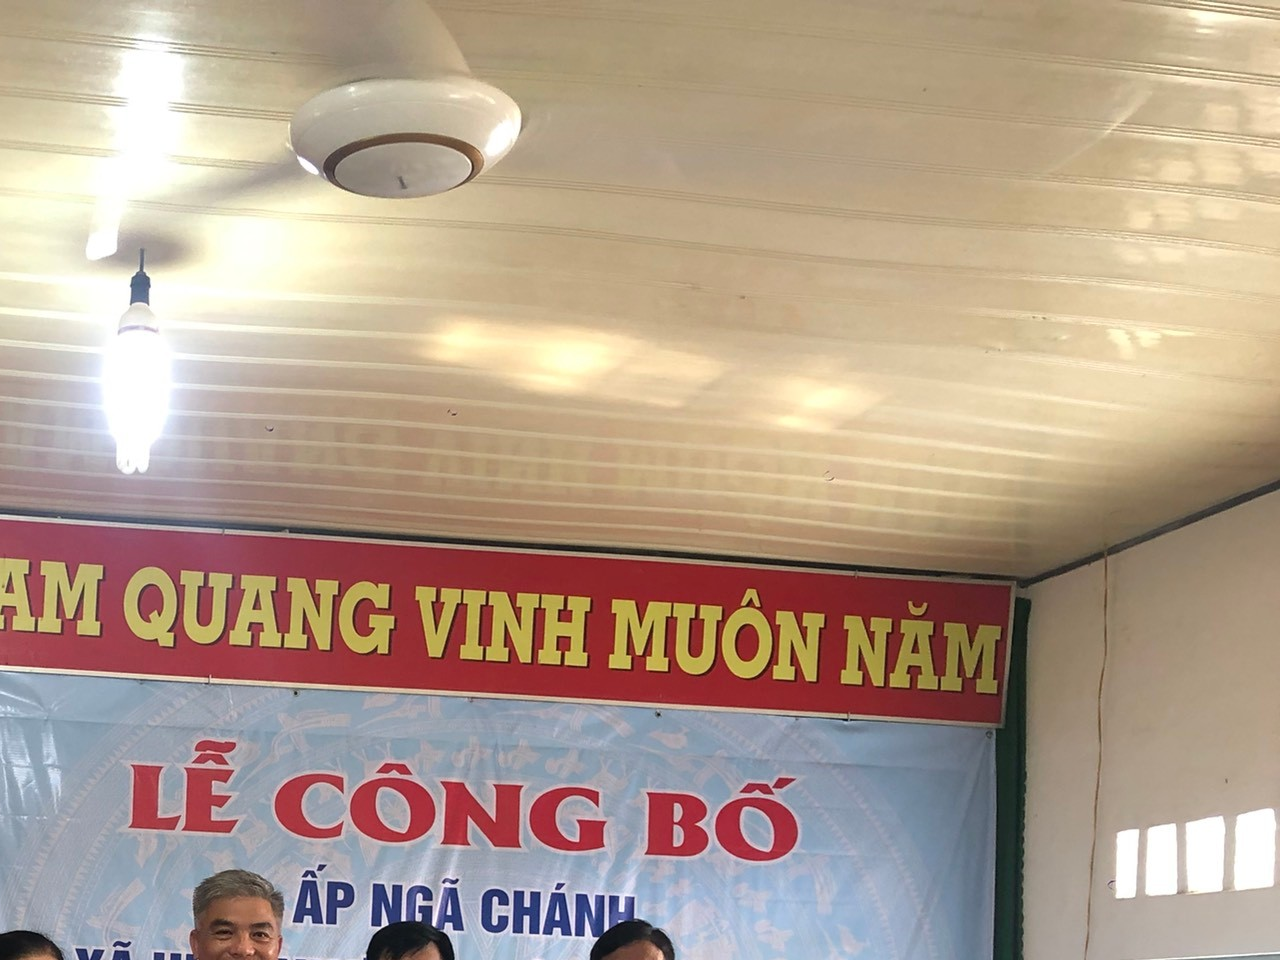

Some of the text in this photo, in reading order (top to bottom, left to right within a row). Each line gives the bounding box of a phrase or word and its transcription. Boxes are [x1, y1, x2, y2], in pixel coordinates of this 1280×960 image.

[123, 566, 395, 655] QUANG
[415, 585, 591, 667] VINH
[608, 588, 825, 682] MUÔN
[840, 600, 1002, 694] NĂM
[128, 740, 799, 862] LỄ CÔNG BỐ
[292, 864, 636, 939] ẤP NGÃ CHÁNH
